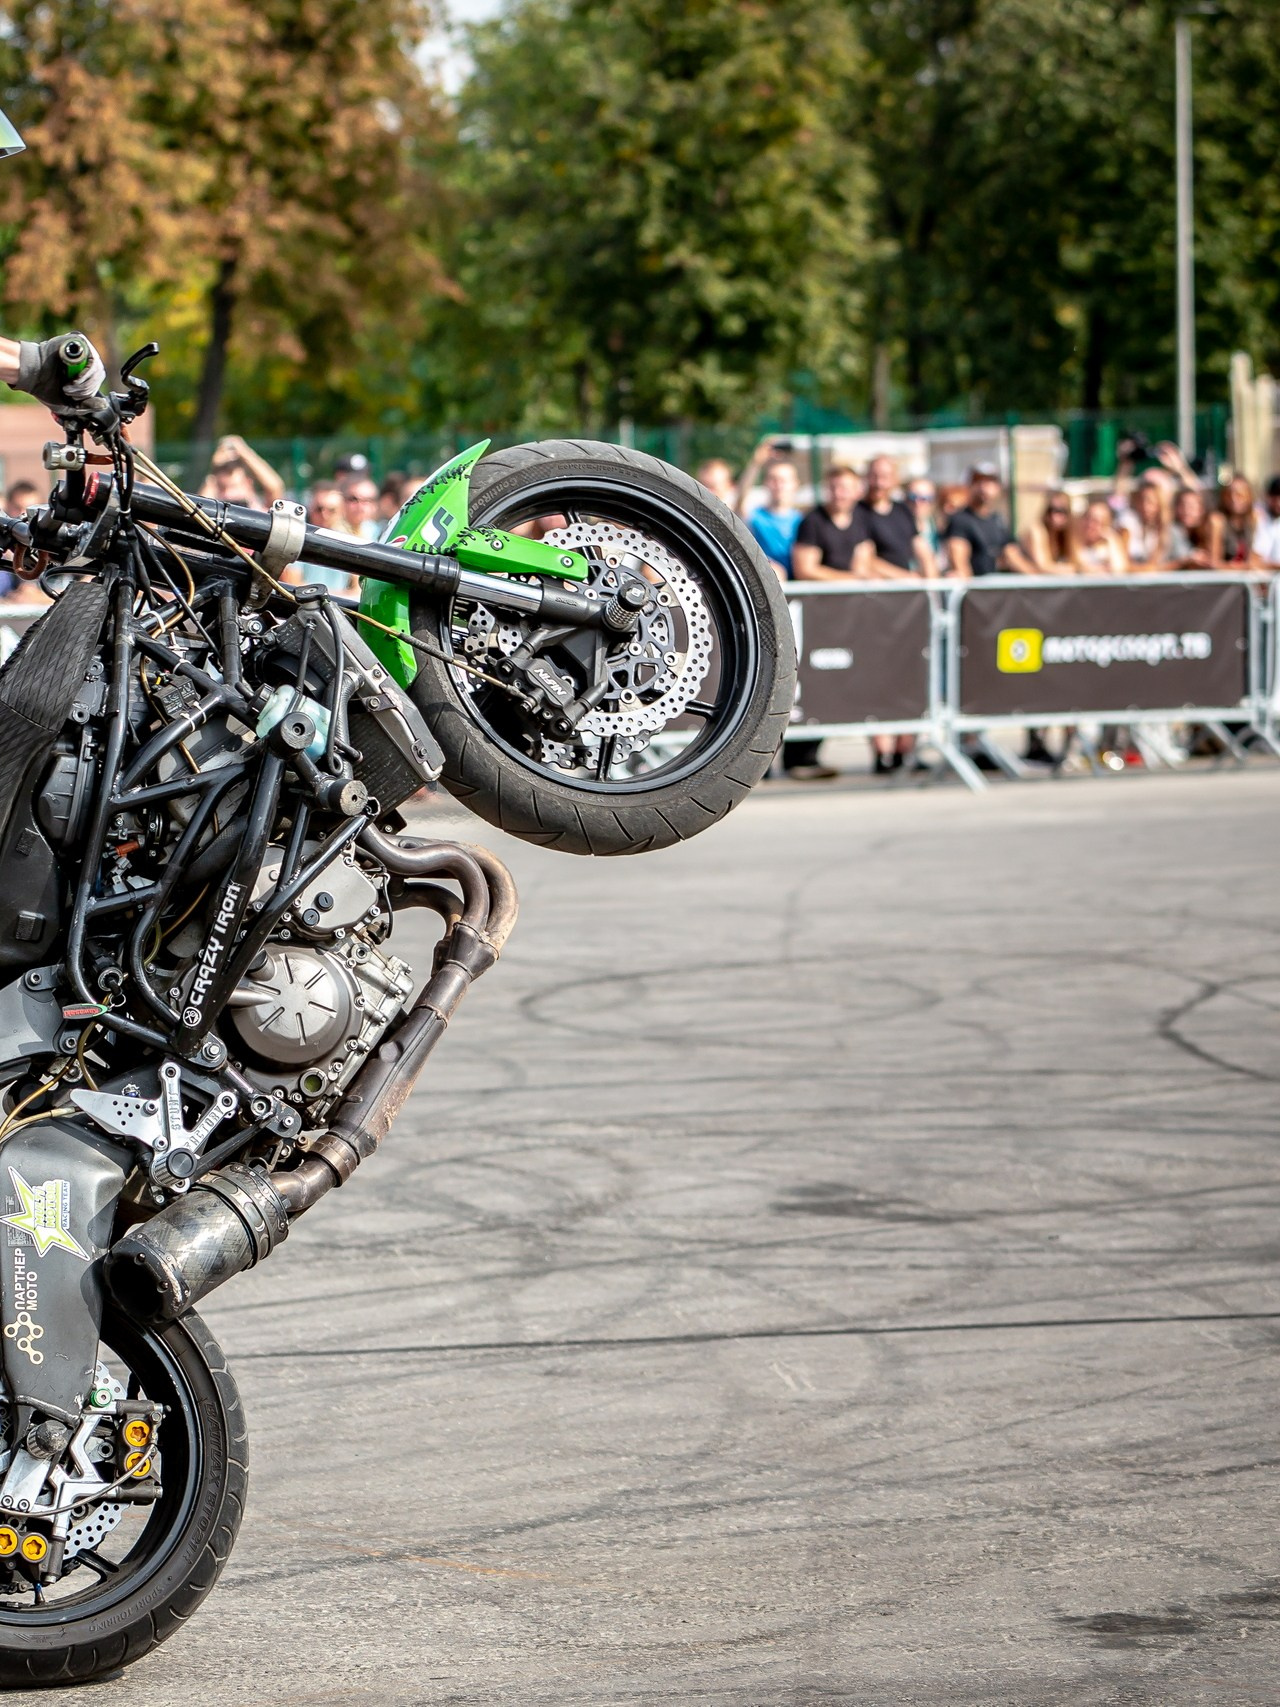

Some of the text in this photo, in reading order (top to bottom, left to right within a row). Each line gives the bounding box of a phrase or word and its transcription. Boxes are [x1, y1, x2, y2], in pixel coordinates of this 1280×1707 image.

[190, 884, 241, 1006] CRAZY IRON
[45, 1183, 56, 1228] MOTOR
[15, 1247, 26, 1310] ПАРТНЕР
[26, 1271, 38, 1311] МОТО
